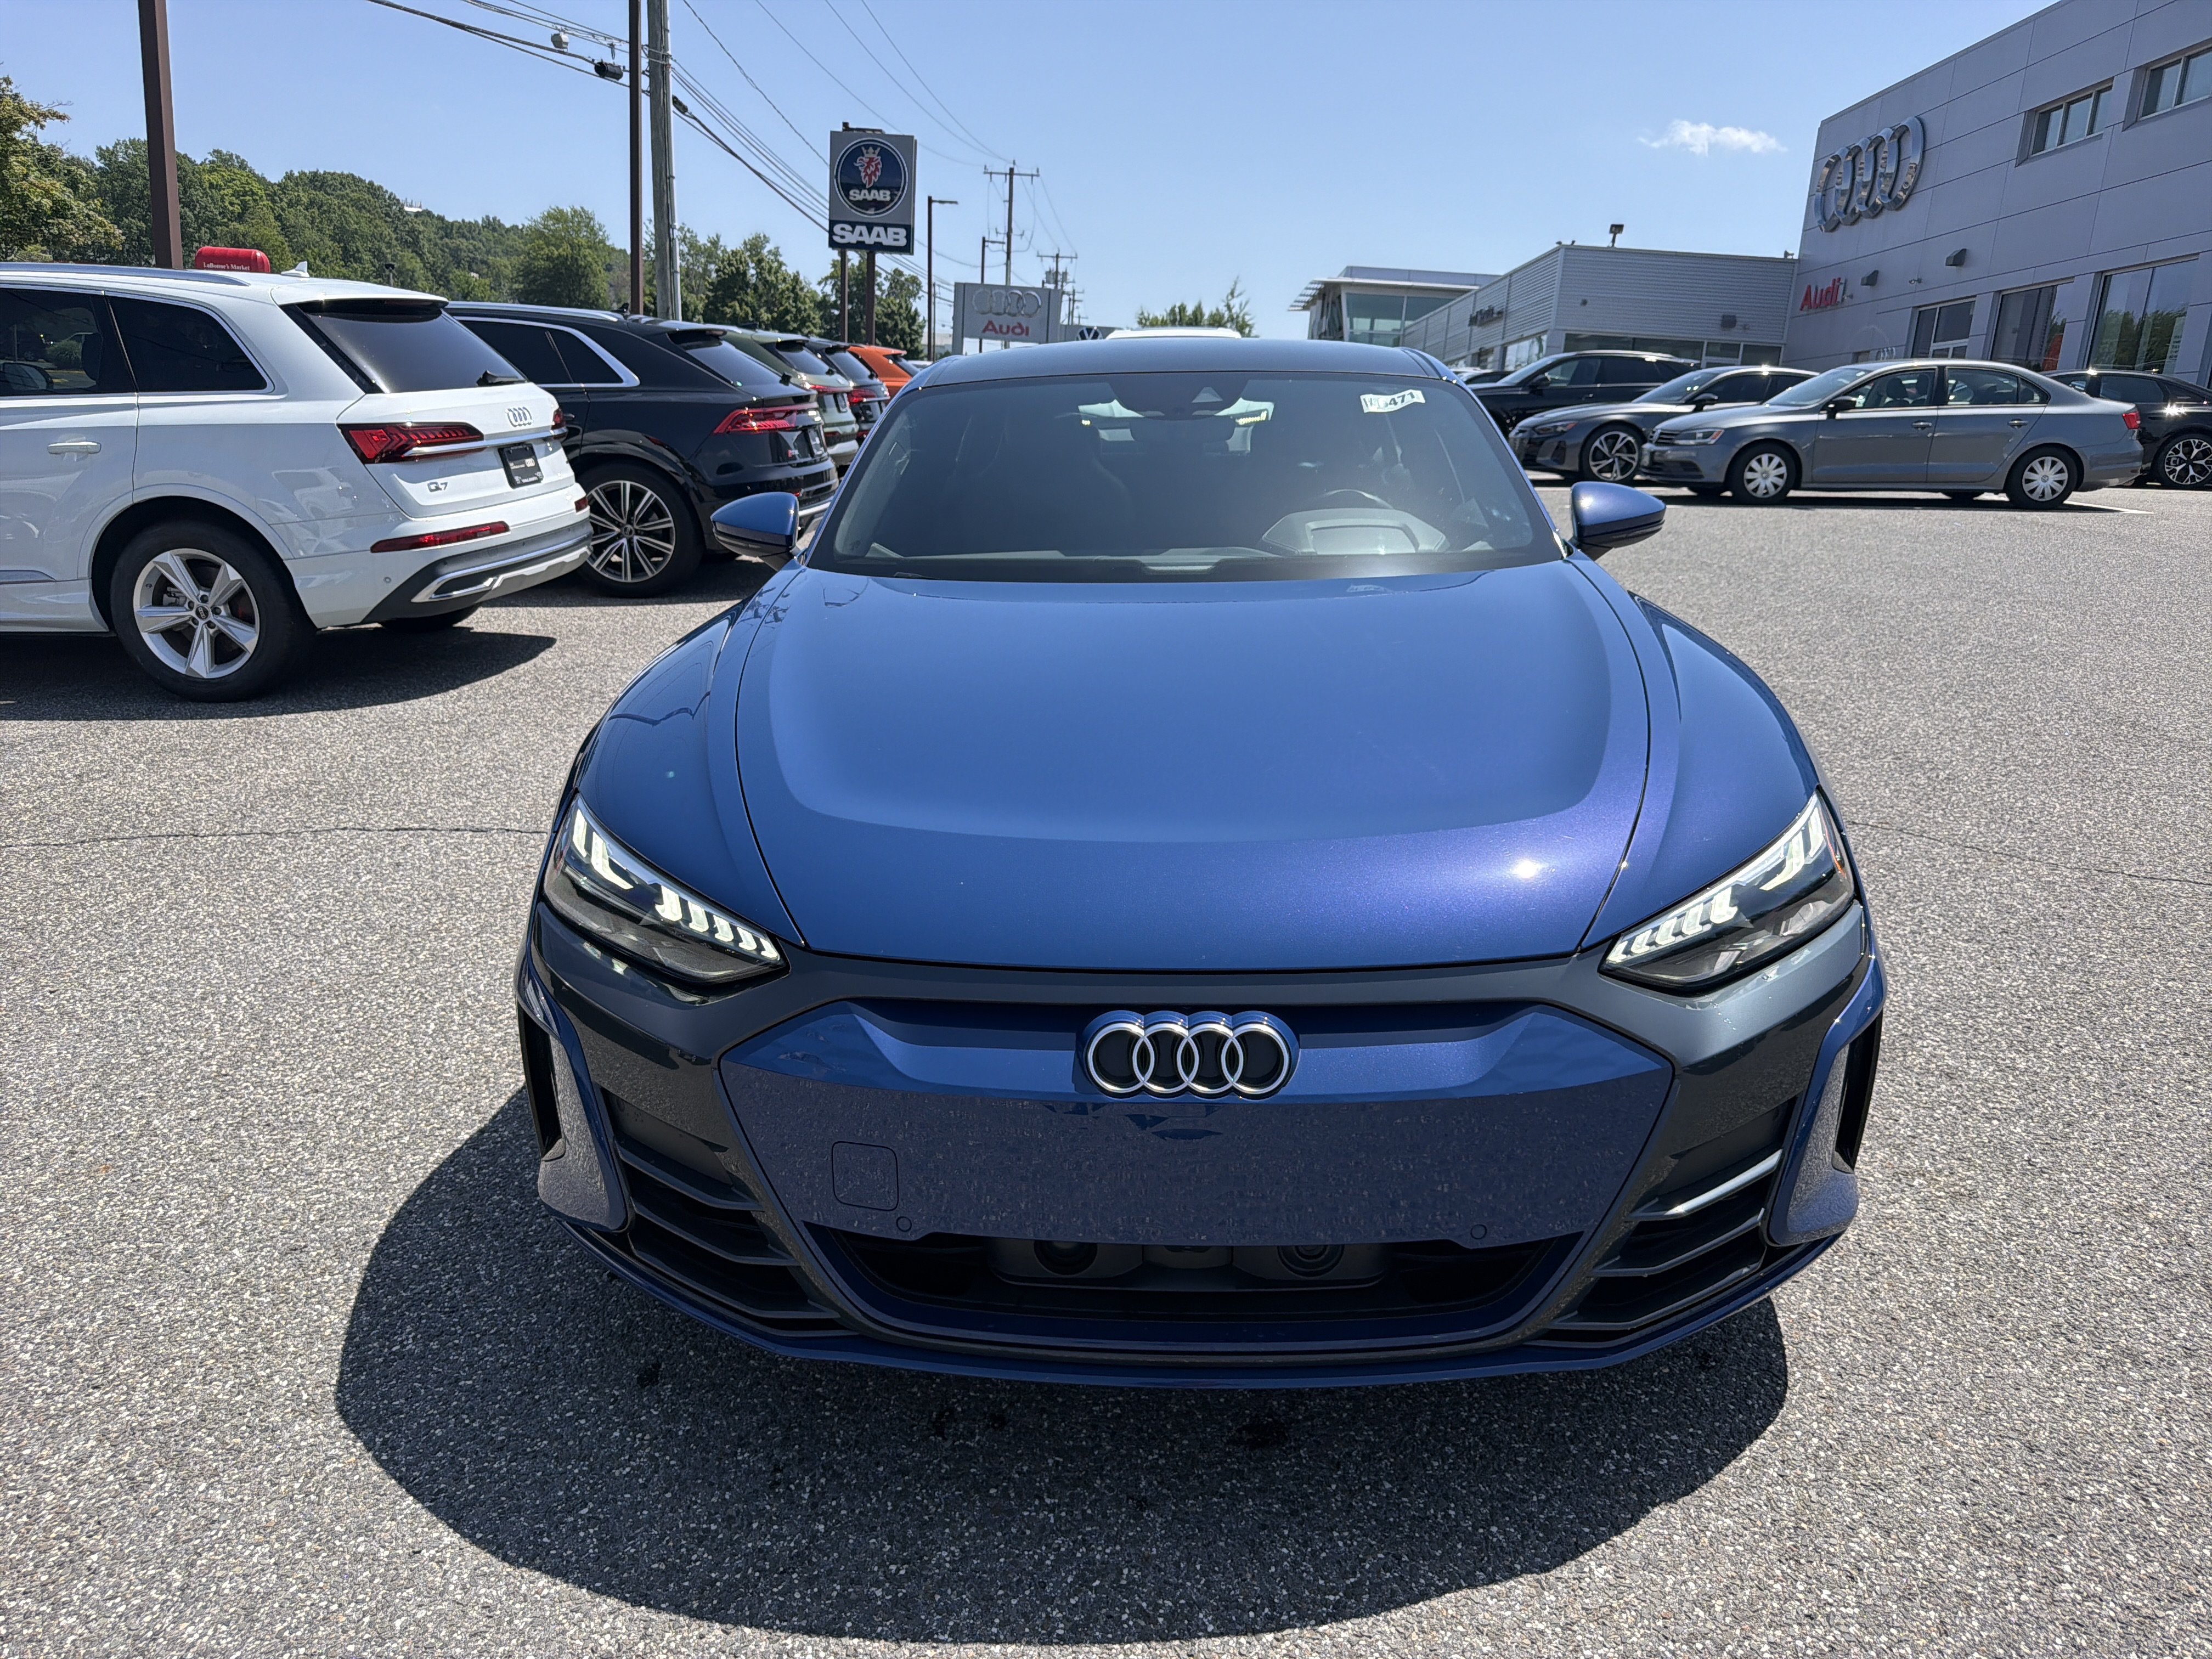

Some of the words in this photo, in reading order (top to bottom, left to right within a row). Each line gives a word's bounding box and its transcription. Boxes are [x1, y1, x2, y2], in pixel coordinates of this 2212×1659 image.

[849, 189, 891, 201] SAAB
[832, 223, 907, 247] SAAB
[1799, 276, 1841, 311] Audi
[981, 319, 1030, 337] Audi
[427, 481, 448, 493] Q7
